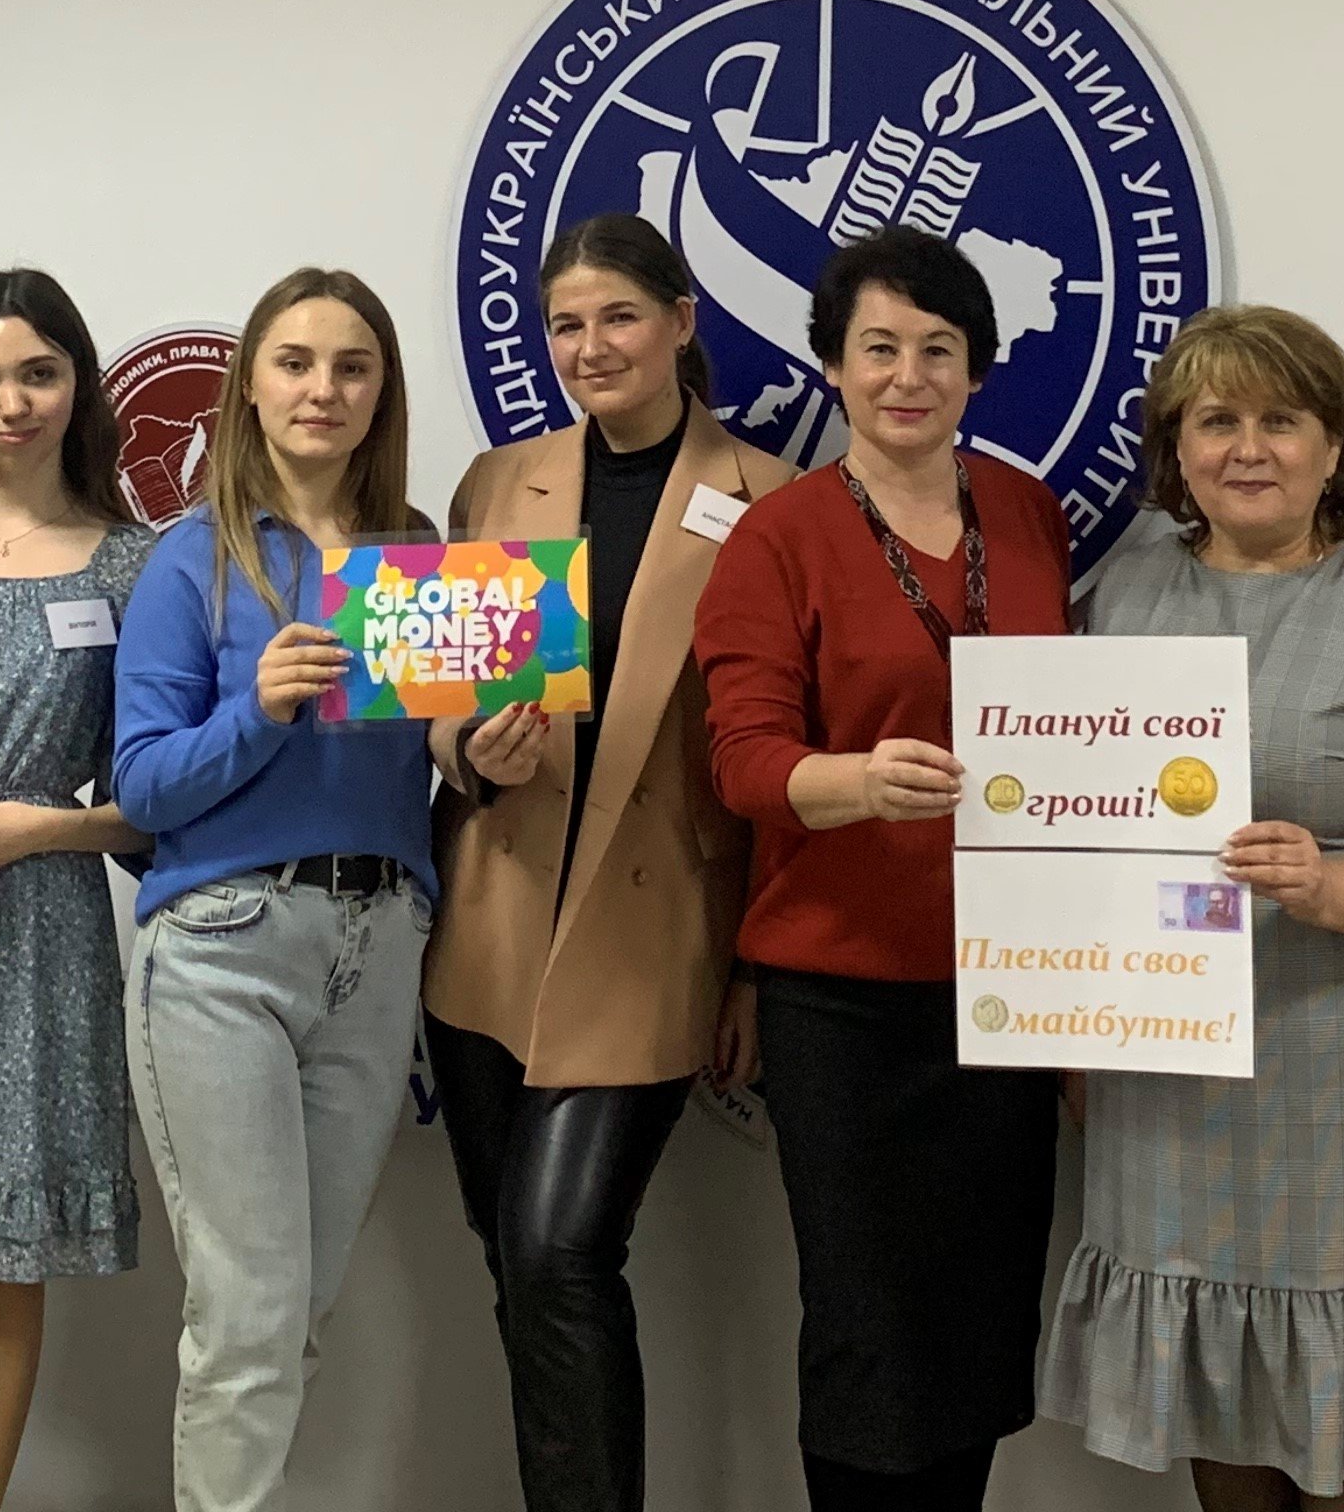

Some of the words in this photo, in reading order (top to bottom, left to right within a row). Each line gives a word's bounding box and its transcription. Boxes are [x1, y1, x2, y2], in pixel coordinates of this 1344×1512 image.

[169, 345, 220, 361] ПРАВА
[1060, 160, 1182, 552] УНІВЕРСИТЕ
[364, 577, 536, 615] GLOBAL
[364, 611, 520, 649] MONEY
[363, 646, 494, 684] WEEK
[976, 705, 1131, 746] Плануй
[1143, 707, 1226, 738] свої
[1026, 786, 1159, 826] гроші!
[958, 938, 1110, 972] Плекай
[1122, 951, 1209, 976] своє
[1009, 1003, 1236, 1048] майбутнє!
